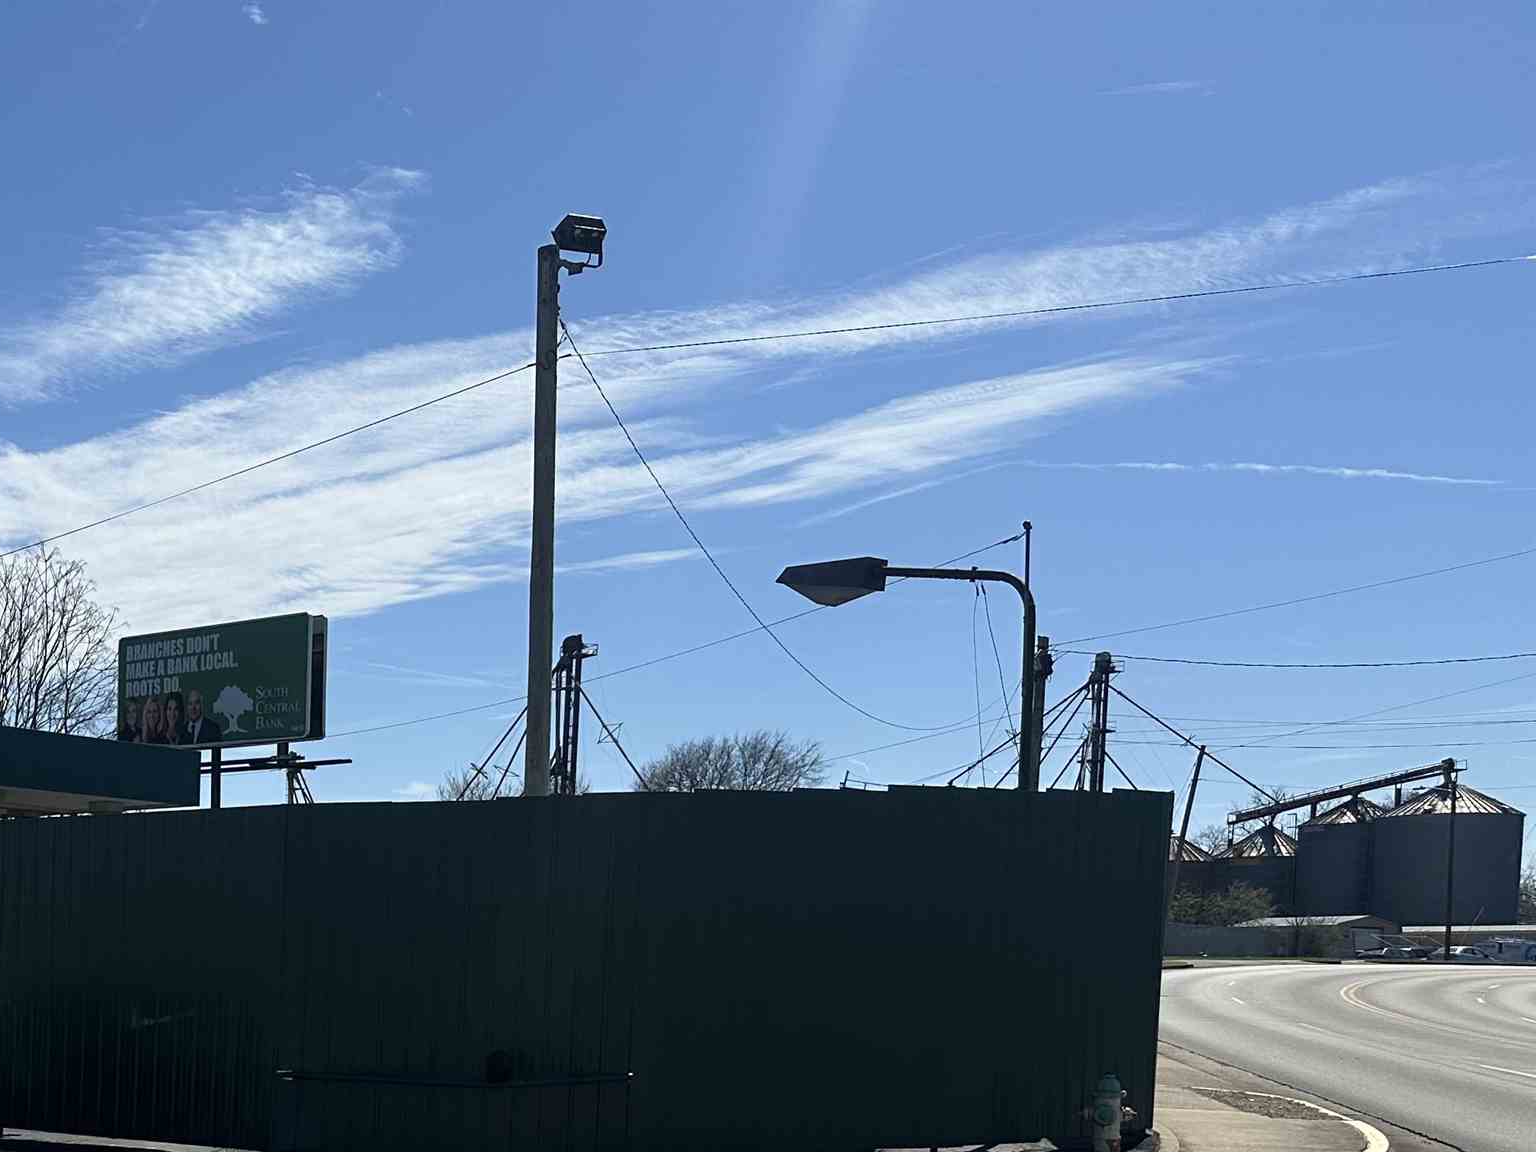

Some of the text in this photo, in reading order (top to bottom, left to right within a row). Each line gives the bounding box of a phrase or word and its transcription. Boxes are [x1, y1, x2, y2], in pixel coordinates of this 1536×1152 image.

[126, 634, 220, 660] BRANCHES DON'T
[126, 652, 239, 680] MAKE A BANK LOCAL.
[126, 675, 182, 698] ROOTS DO.
